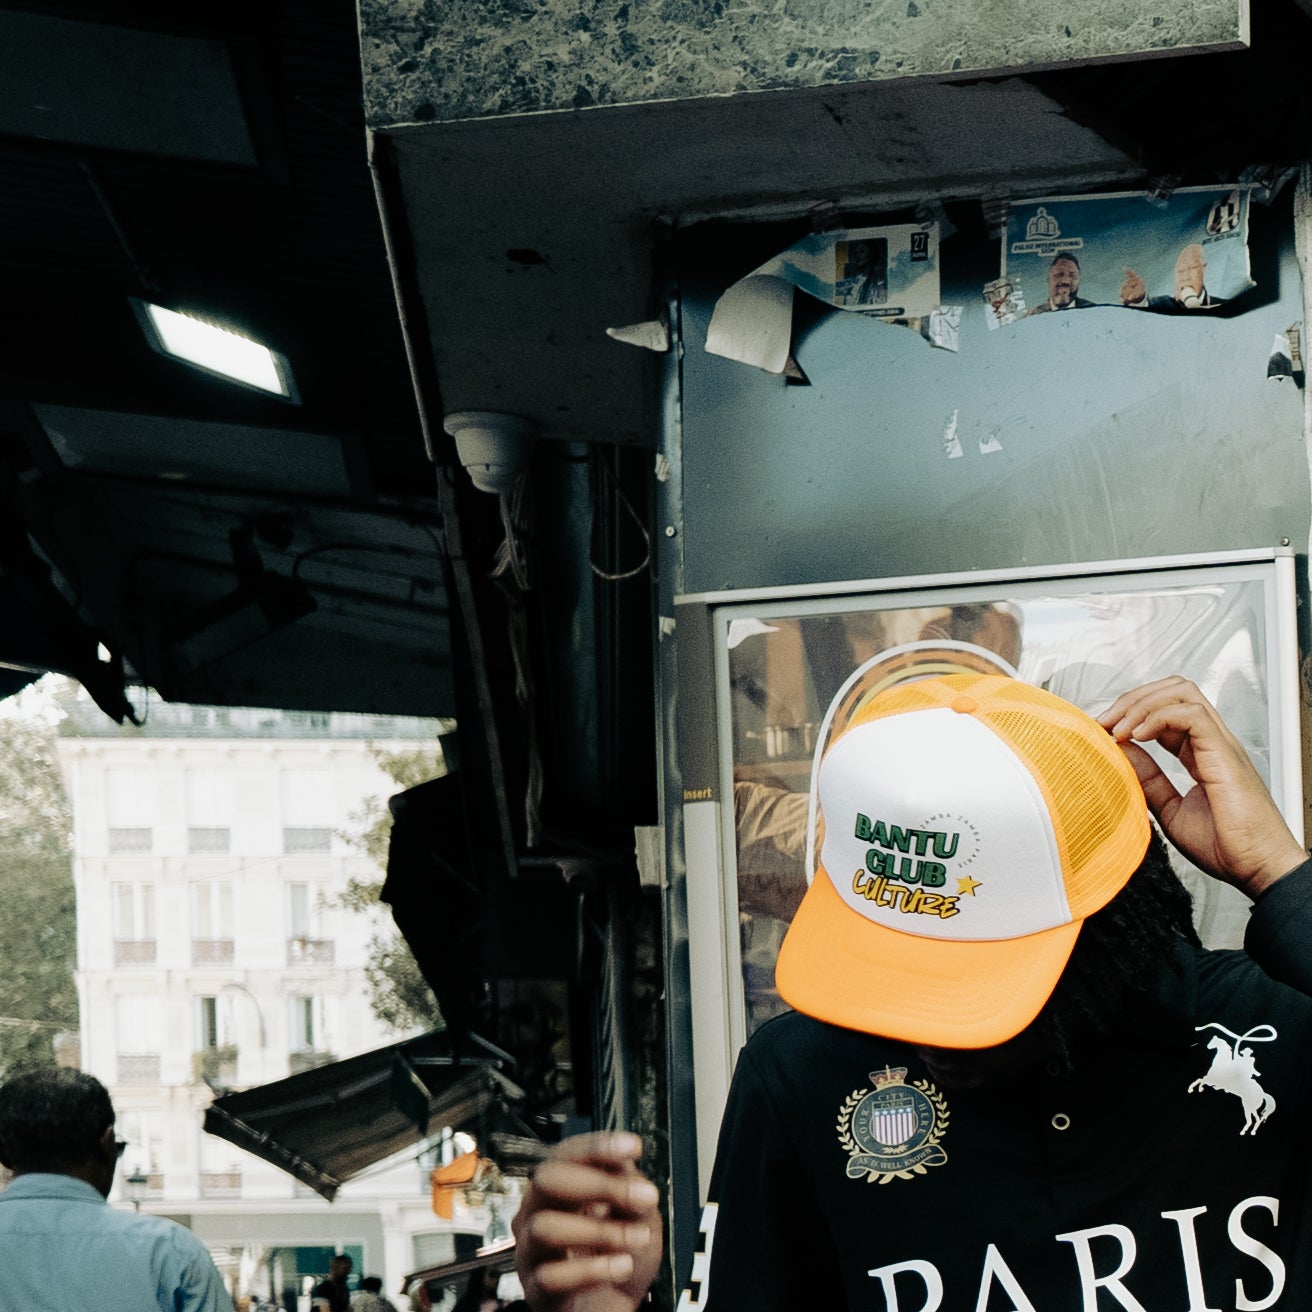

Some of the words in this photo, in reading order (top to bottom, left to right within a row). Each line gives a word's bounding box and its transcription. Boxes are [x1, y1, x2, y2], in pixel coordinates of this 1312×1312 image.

[855, 813, 959, 859] BANTU
[866, 849, 946, 888] CLUB
[852, 869, 960, 919] CULTURE
[858, 1108, 870, 1142] YOUR
[877, 1091, 905, 1101] CITY
[918, 1102, 931, 1137] HERE
[880, 1160, 902, 1169] WELL
[904, 1147, 932, 1166] KNOWN
